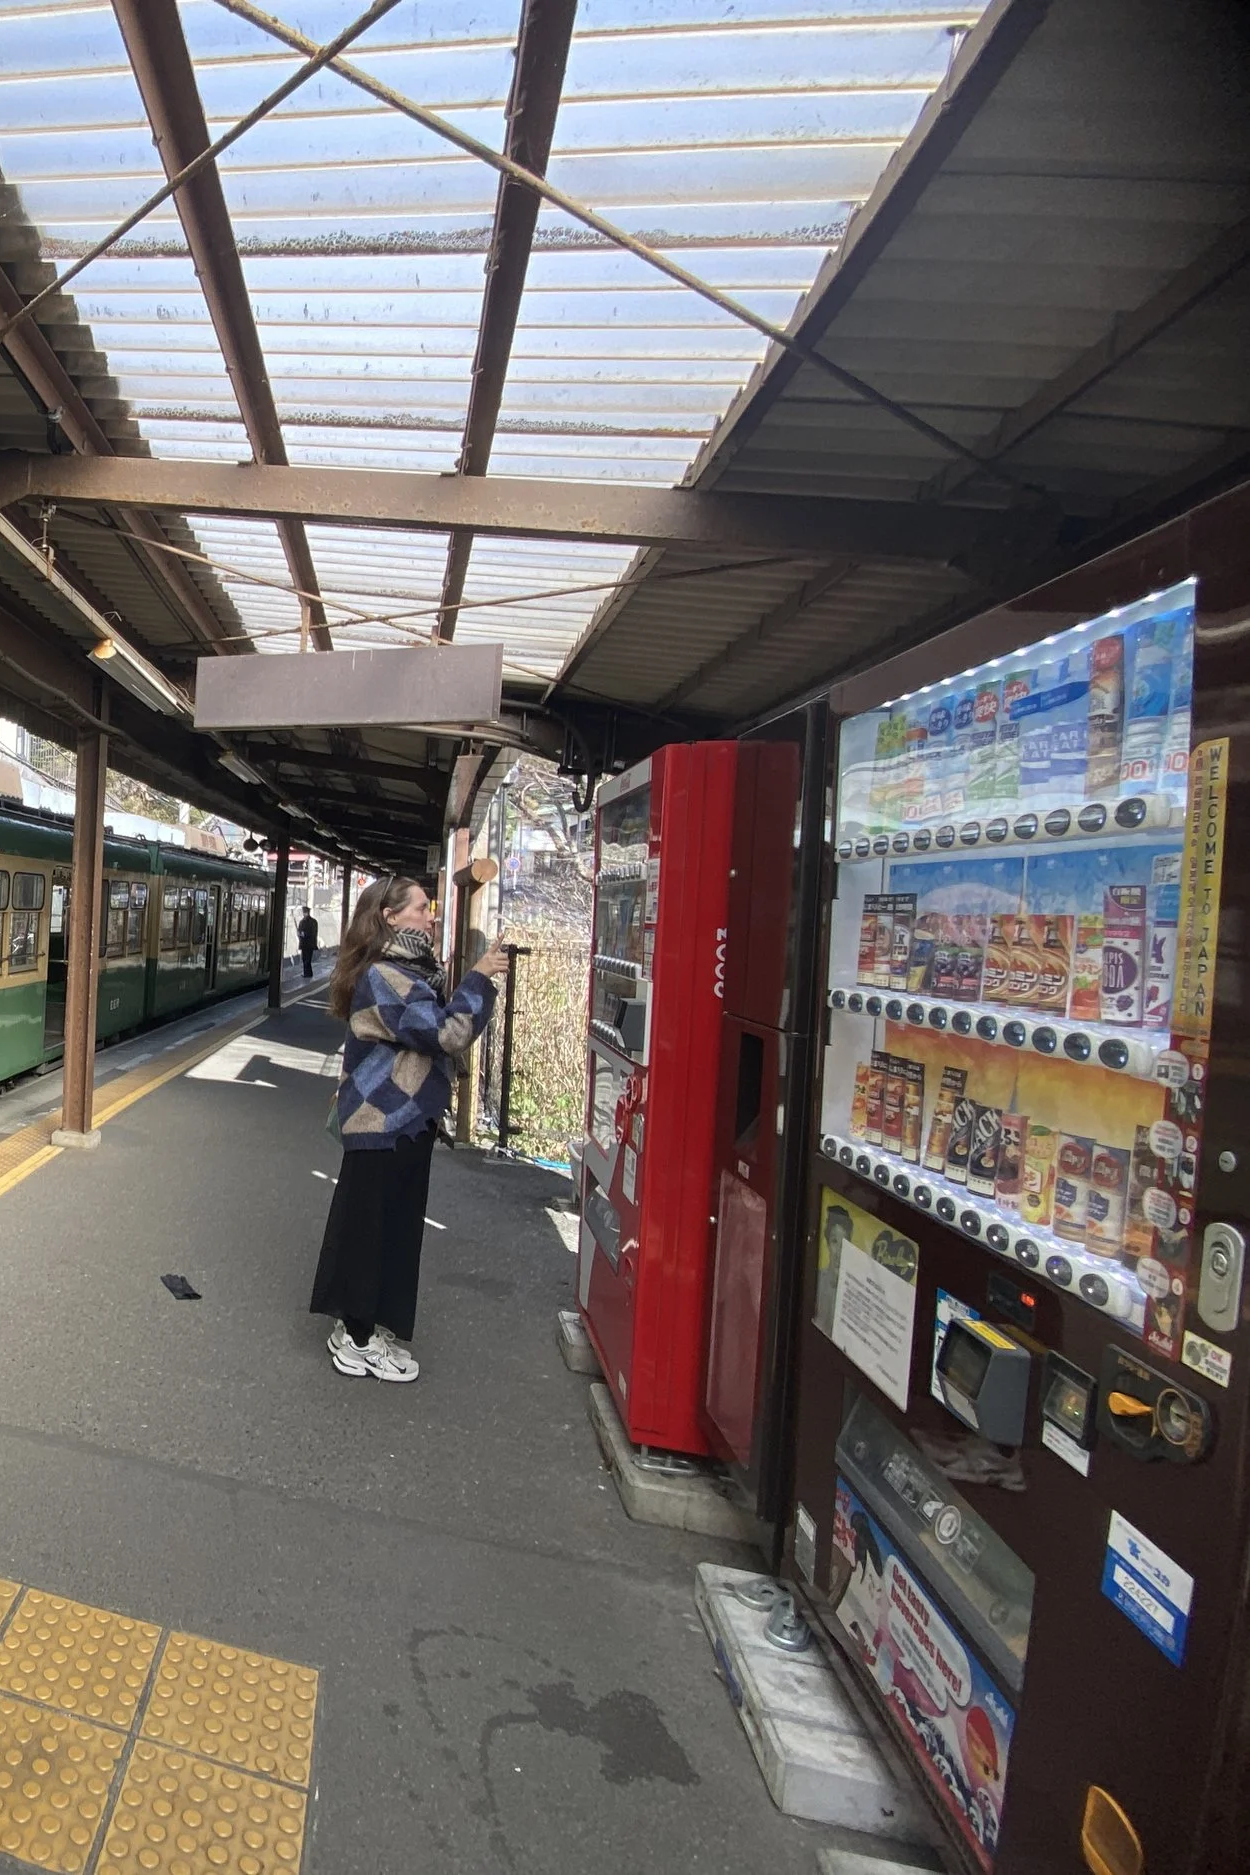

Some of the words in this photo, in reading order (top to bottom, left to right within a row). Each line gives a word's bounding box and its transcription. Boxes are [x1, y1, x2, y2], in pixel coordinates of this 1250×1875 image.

[1204, 747, 1223, 874] WELCOME
[1201, 888, 1212, 917] TO
[1195, 927, 1210, 1017] JAPAN
[892, 1563, 908, 1597] Get
